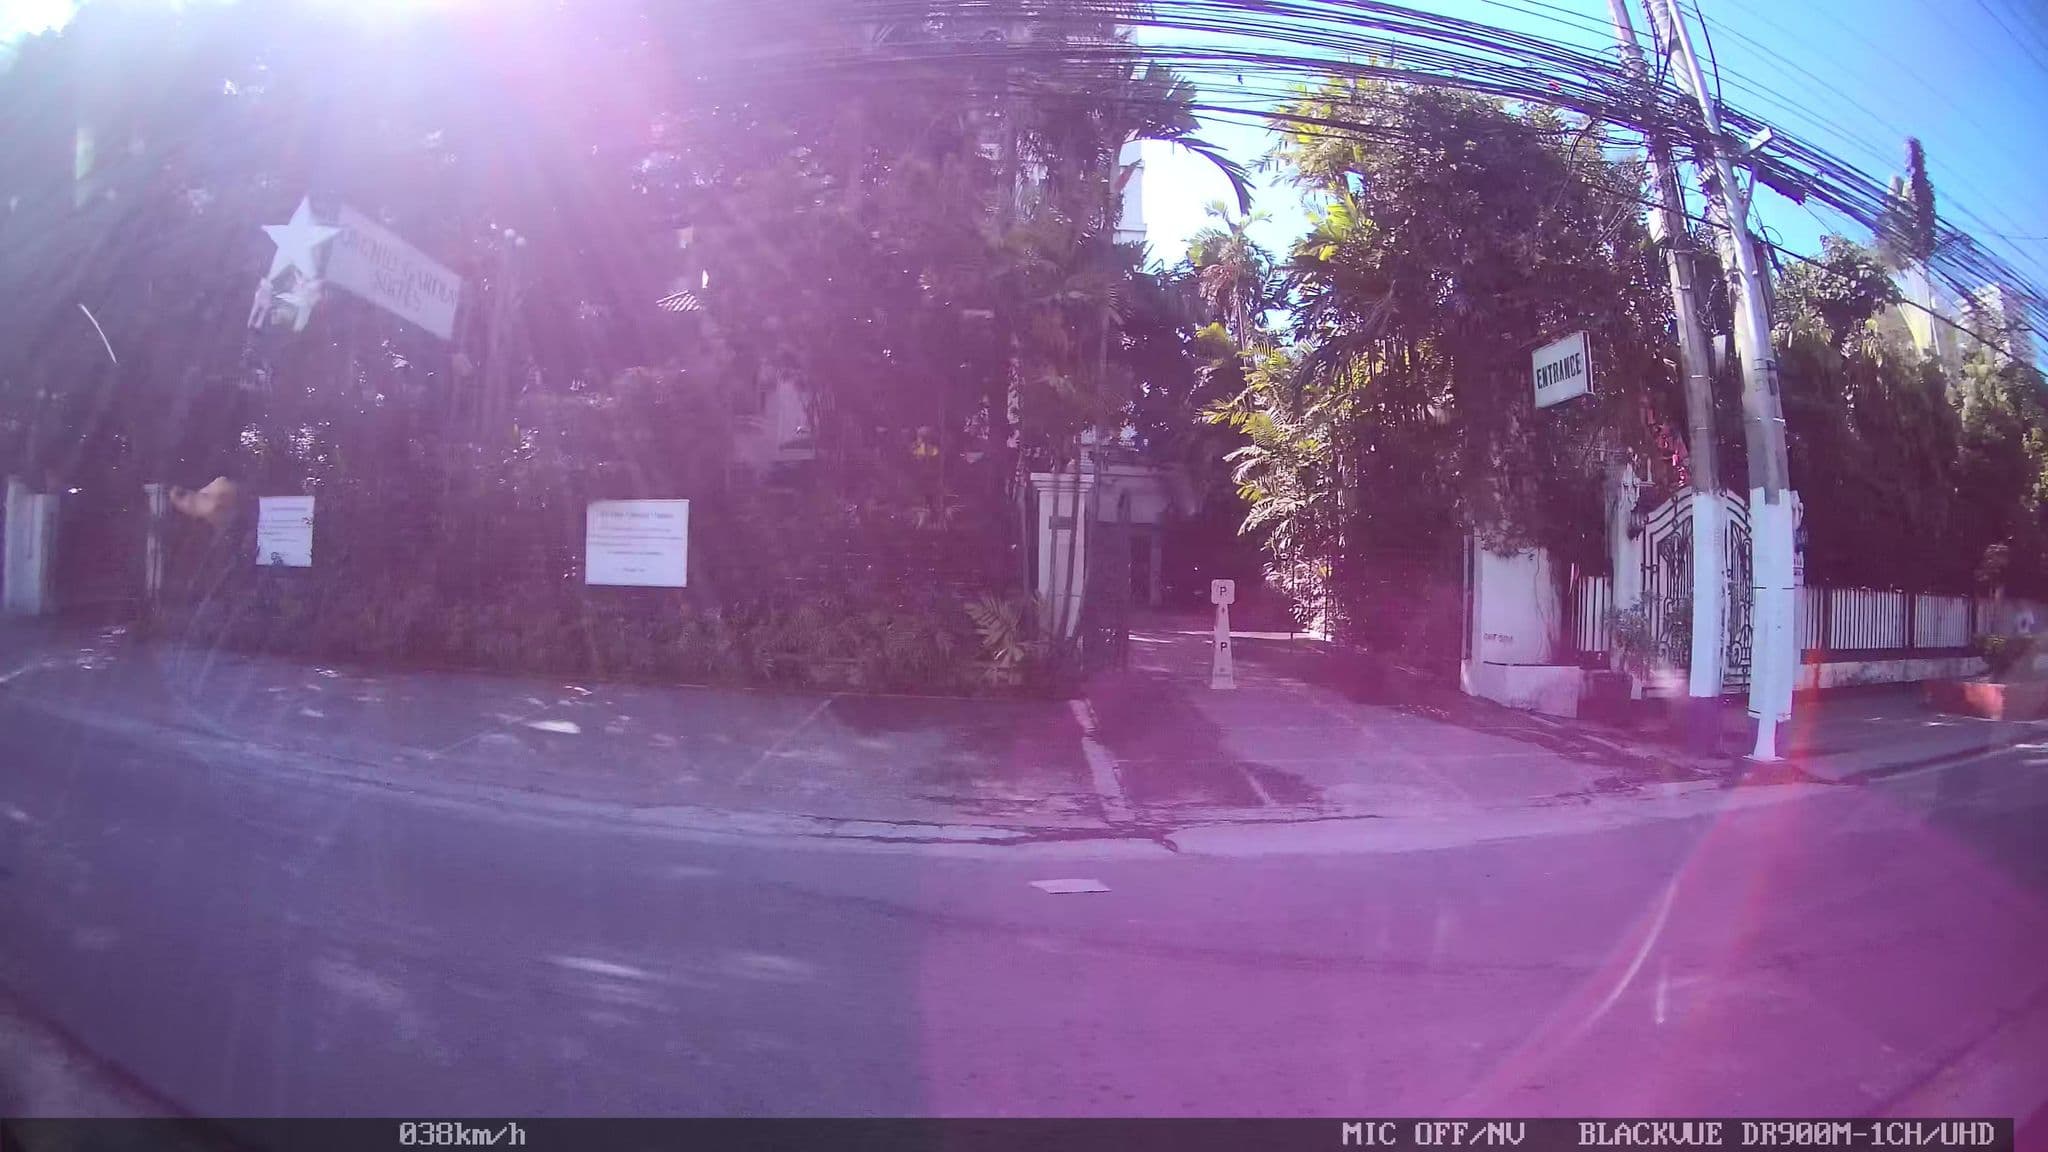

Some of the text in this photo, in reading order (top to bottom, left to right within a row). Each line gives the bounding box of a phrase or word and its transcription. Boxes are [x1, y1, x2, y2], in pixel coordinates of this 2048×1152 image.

[1536, 352, 1582, 390] ENTRANCE
[1219, 586, 1227, 596] P
[1220, 642, 1228, 653] P
